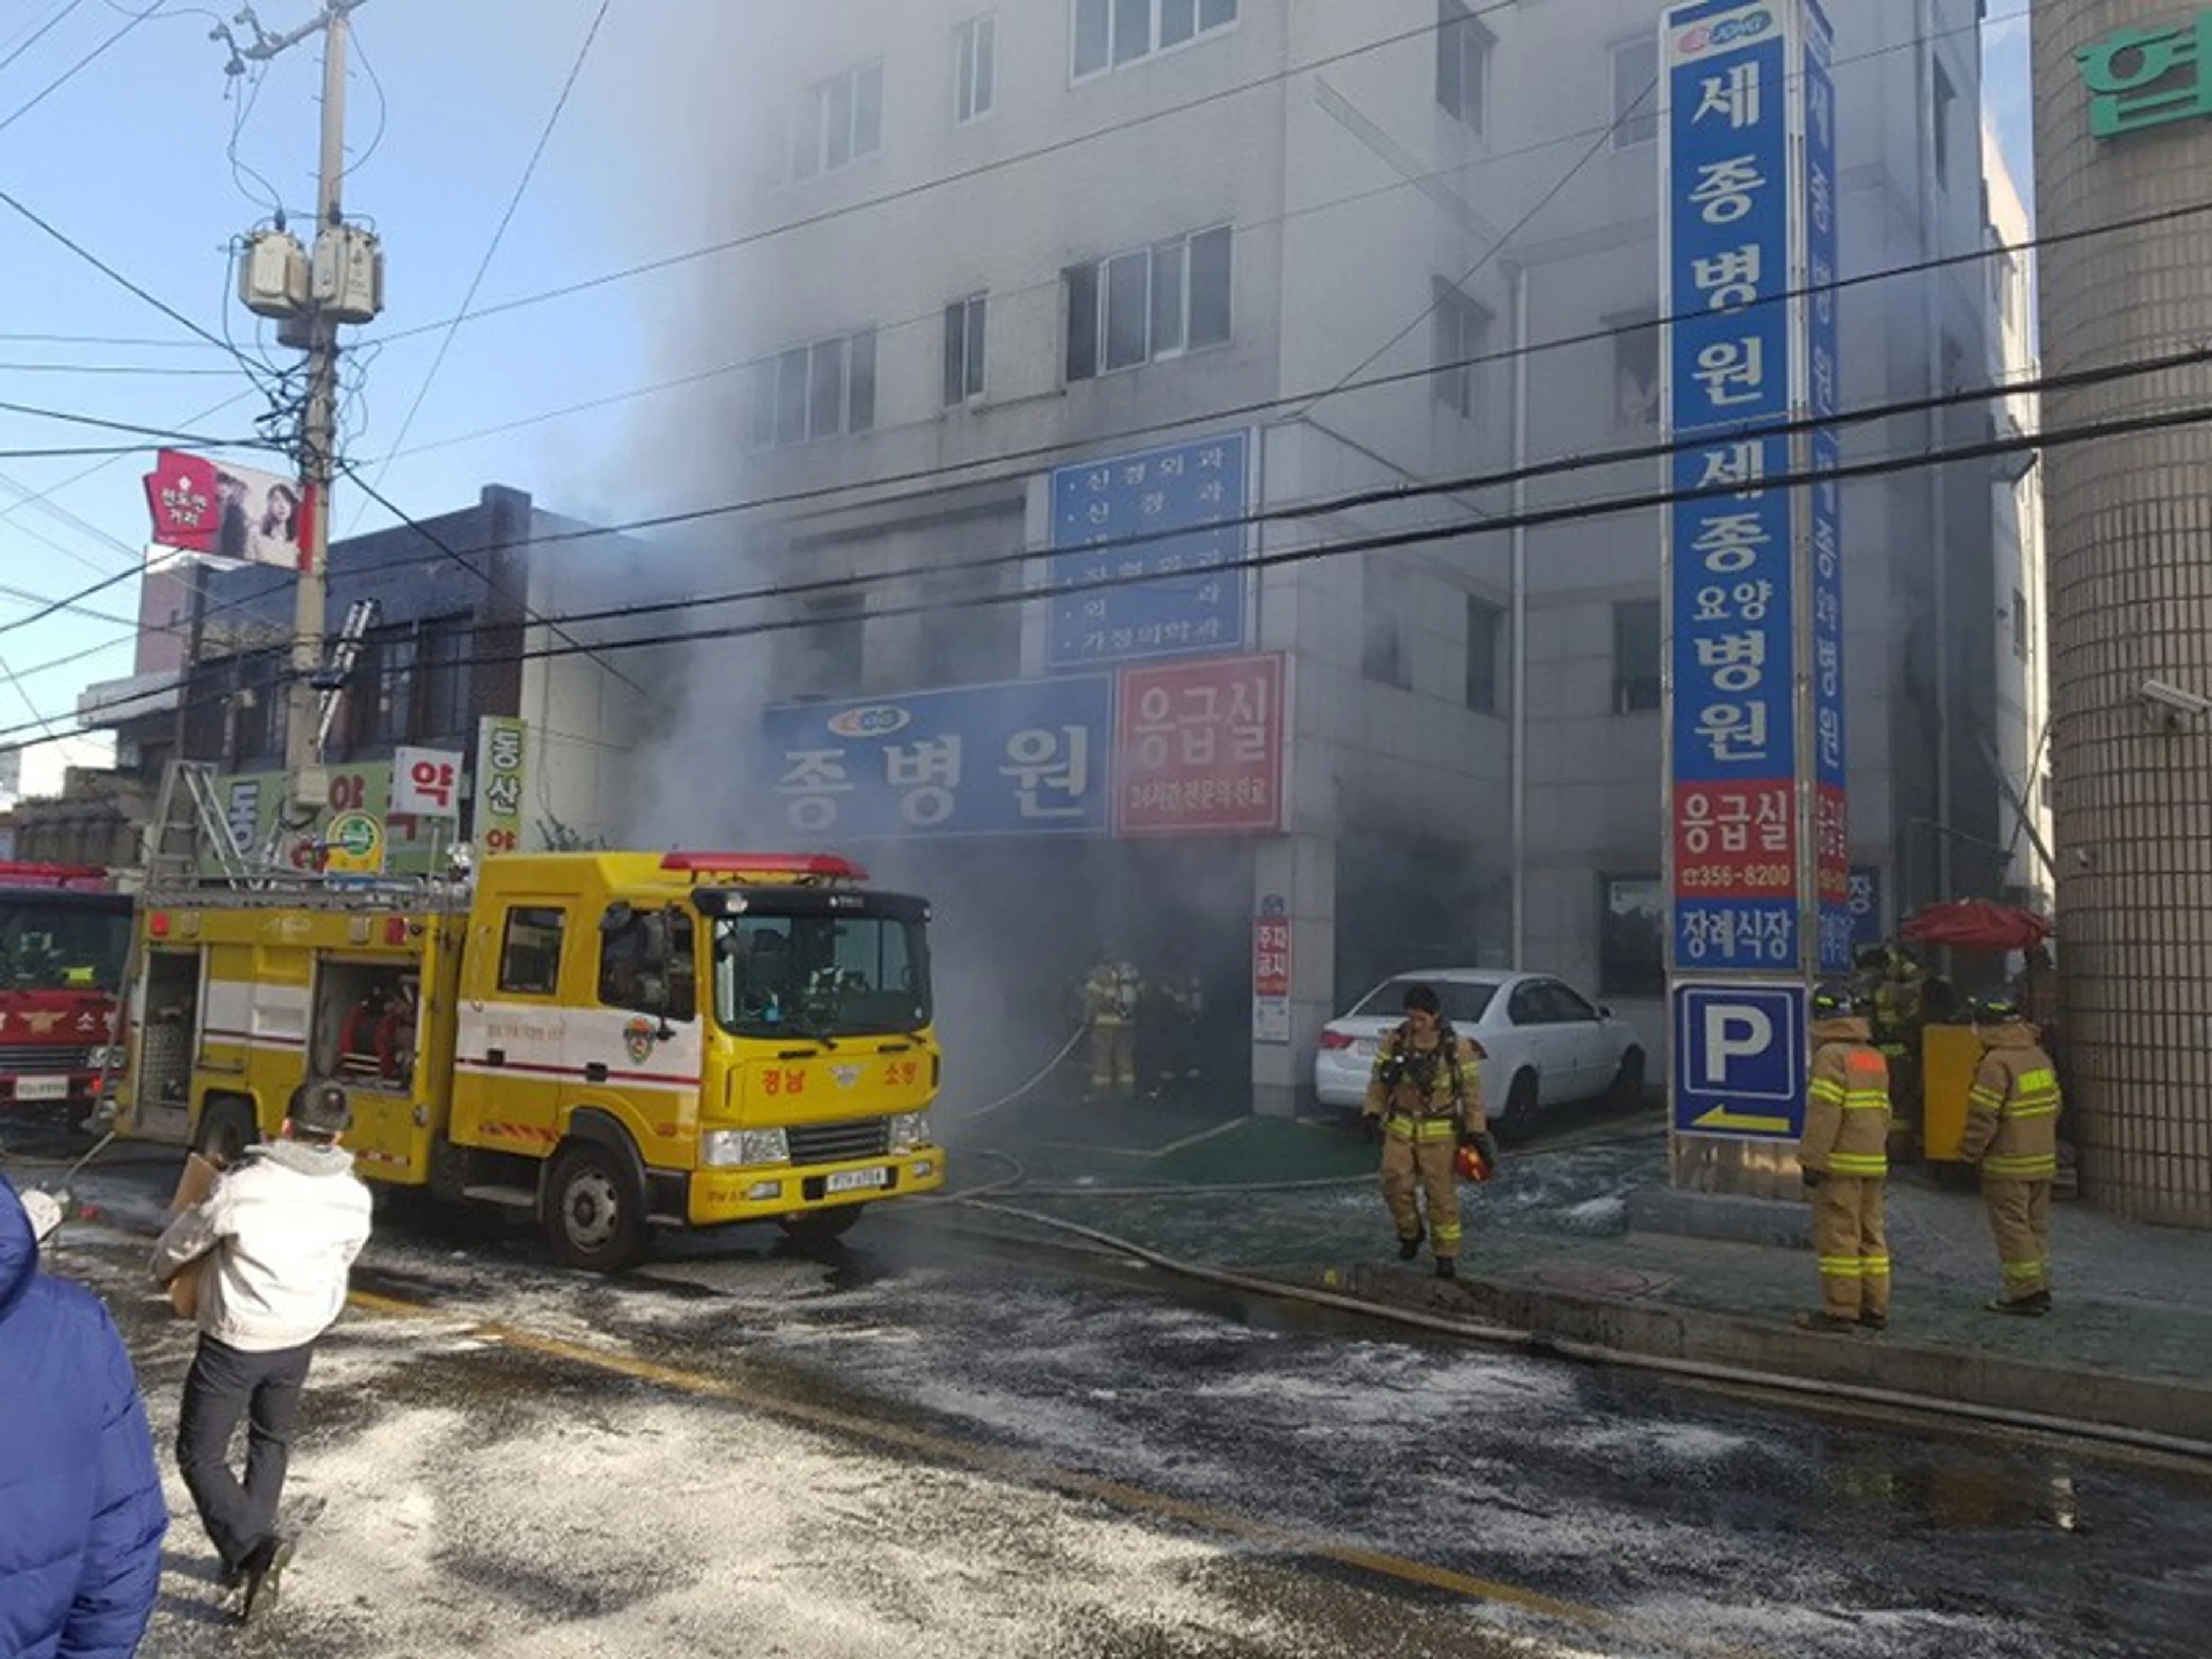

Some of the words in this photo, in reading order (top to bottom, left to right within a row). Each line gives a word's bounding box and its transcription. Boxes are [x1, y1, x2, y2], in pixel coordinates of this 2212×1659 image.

[1136, 677, 1266, 770] 응급실
[412, 761, 454, 806] 약
[1681, 790, 1787, 854] 응급실
[1681, 908, 1794, 960] 장례식장
[1705, 1004, 1772, 1082] P
[762, 1069, 805, 1096] 경남
